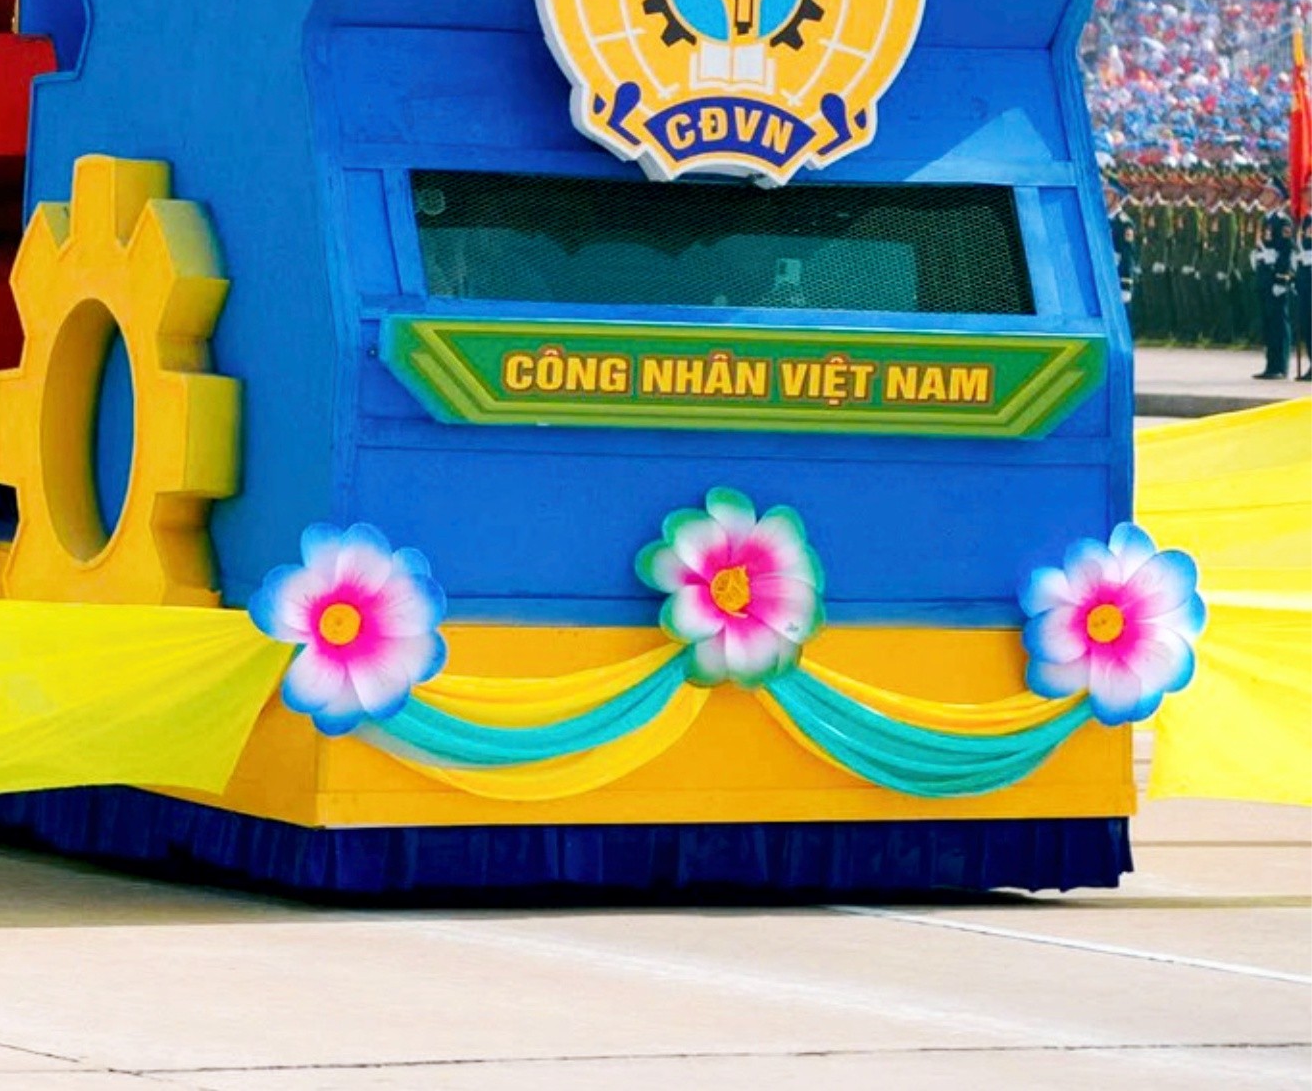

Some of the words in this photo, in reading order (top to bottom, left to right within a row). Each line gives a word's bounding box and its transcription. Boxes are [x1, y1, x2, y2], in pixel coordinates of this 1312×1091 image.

[666, 106, 794, 155] CĐVN
[505, 348, 628, 391] CÔNG
[641, 352, 767, 397] NHÂN
[780, 356, 874, 405] VIỆT
[886, 364, 989, 402] NAM
